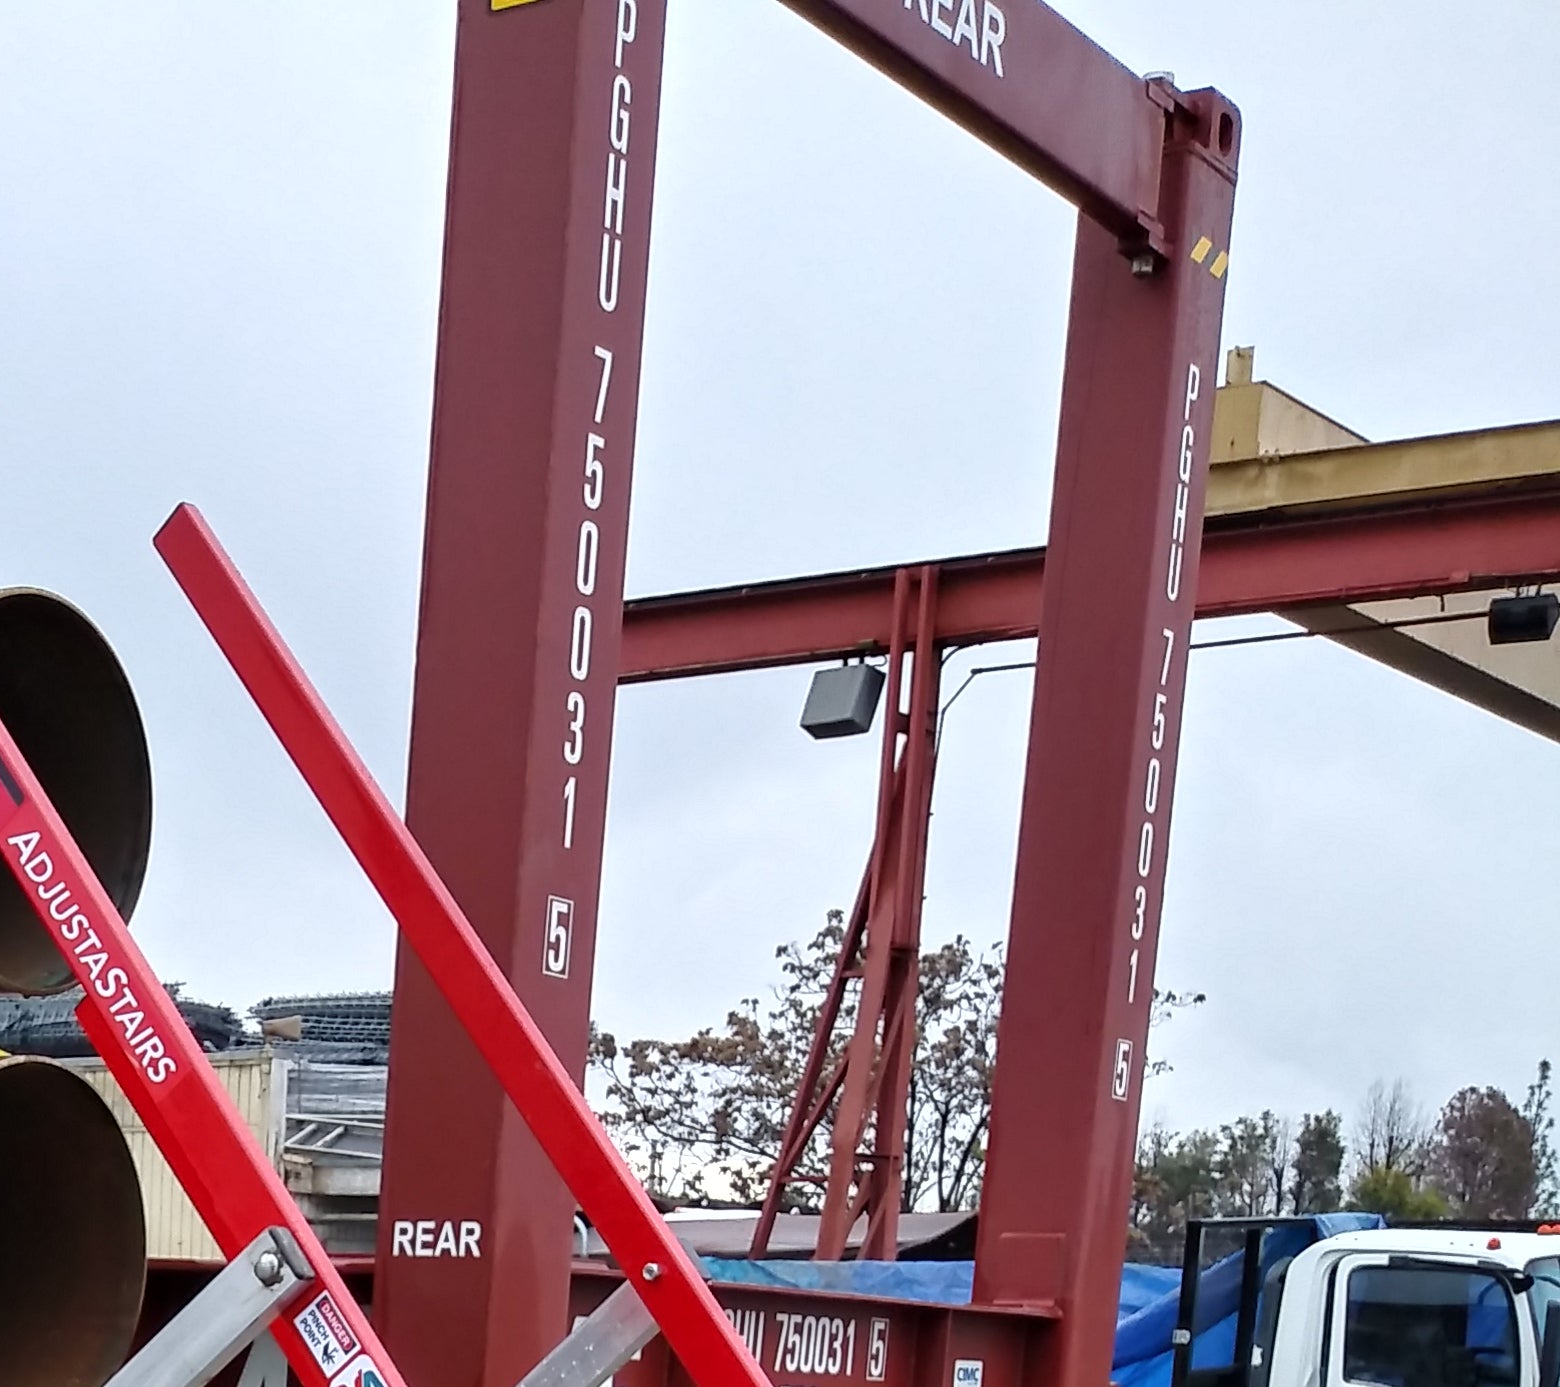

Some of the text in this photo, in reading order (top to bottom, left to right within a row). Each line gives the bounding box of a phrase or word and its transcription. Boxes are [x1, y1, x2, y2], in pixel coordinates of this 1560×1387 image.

[546, 0, 638, 973] PGHU 750031 5
[1164, 363, 1200, 602] PGHU
[1126, 627, 1176, 1004] 750031
[7, 829, 178, 1084] ADJUSTASTAIRS
[391, 1219, 481, 1260] REAR
[299, 1317, 321, 1348] POINT
[308, 1309, 329, 1341] PINCH
[320, 1302, 352, 1349] DANGER
[775, 1312, 857, 1376] 750031
[869, 1320, 887, 1377] 5
